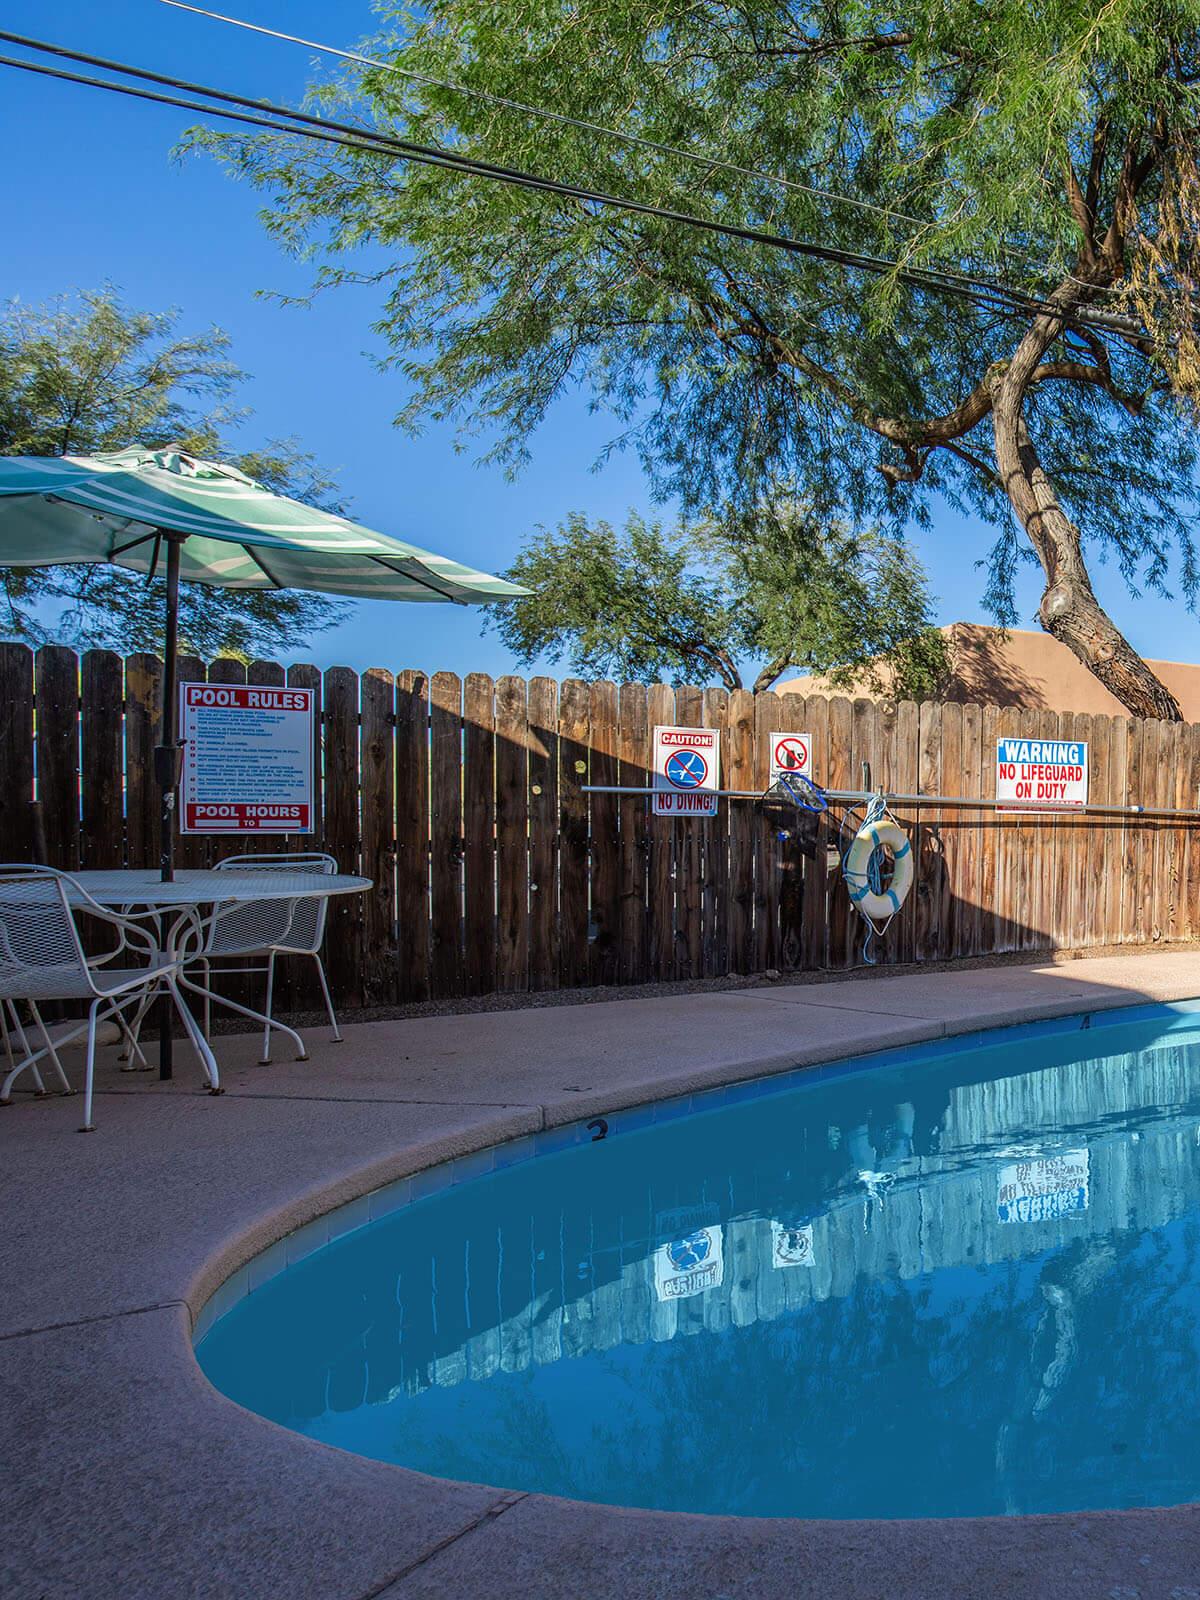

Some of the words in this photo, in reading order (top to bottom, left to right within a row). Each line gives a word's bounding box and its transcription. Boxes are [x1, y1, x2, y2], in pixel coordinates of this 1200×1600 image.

[190, 689, 241, 706] POOL
[248, 692, 305, 709] RULES
[662, 734, 712, 747] CAUTION!
[1004, 741, 1079, 764] WARNING
[1000, 763, 1016, 780] NO
[1021, 764, 1082, 782] LIFEGUARD
[1016, 782, 1031, 798] ON
[1037, 783, 1067, 799] DUTY
[658, 794, 672, 810] NO
[677, 794, 712, 810] DIVING!
[195, 806, 239, 817] POOL
[246, 806, 300, 817] HOURS
